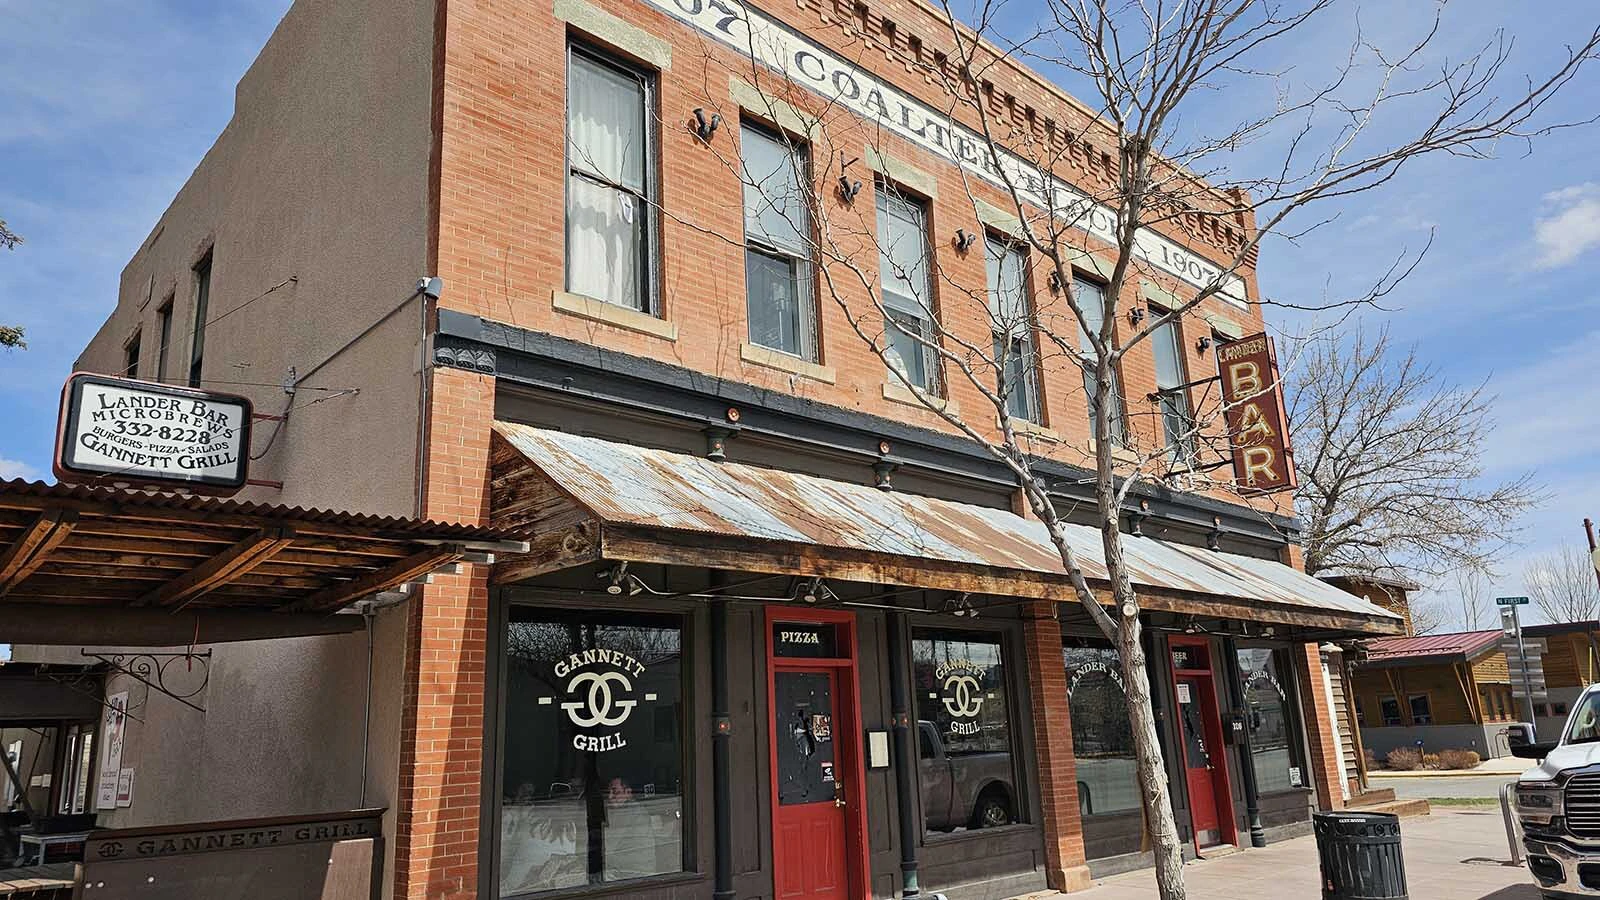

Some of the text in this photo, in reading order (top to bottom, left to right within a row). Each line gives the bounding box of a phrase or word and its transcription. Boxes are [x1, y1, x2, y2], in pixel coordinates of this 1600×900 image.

[1160, 244, 1217, 285] 1907
[92, 408, 233, 439] MICROBREWS
[98, 393, 229, 427] LANDER BAR
[1229, 361, 1280, 488] BAR
[113, 420, 211, 445] 332-8228
[80, 432, 237, 469] GANNETT GRILL
[780, 631, 819, 644] PIZZA
[554, 649, 646, 678] GANNETT
[935, 659, 986, 680] GANNETT
[573, 732, 627, 752] GRILL
[950, 721, 981, 735] GRILL
[137, 830, 282, 855] GANNETT
[295, 822, 369, 841] GRILL
